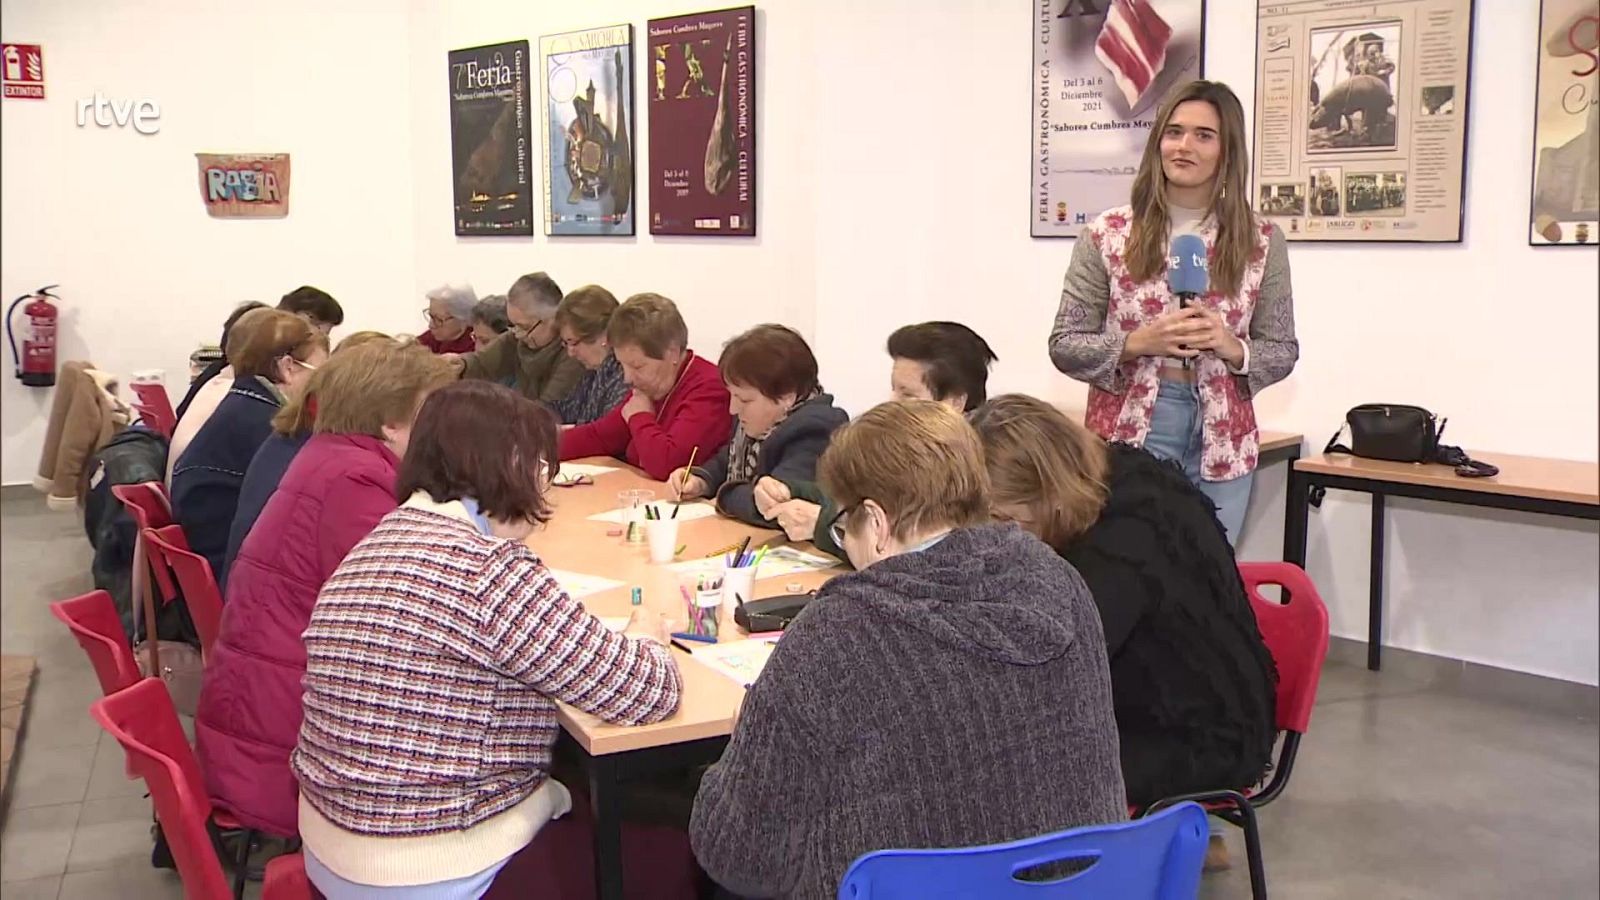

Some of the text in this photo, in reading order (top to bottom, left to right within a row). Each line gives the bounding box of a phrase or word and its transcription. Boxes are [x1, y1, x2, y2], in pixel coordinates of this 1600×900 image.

[466, 58, 511, 88] Feria
[1063, 77, 1103, 88] Del 3 al 6
[6, 86, 43, 97] EXTINTOR
[1060, 90, 1103, 100] Diciembre
[1082, 102, 1102, 111] 2021
[1039, 59, 1050, 176] GASTRONÓMICA
[1090, 120, 1131, 130] Cumbres
[1133, 120, 1154, 129] May
[1039, 182, 1048, 222] FERIA
